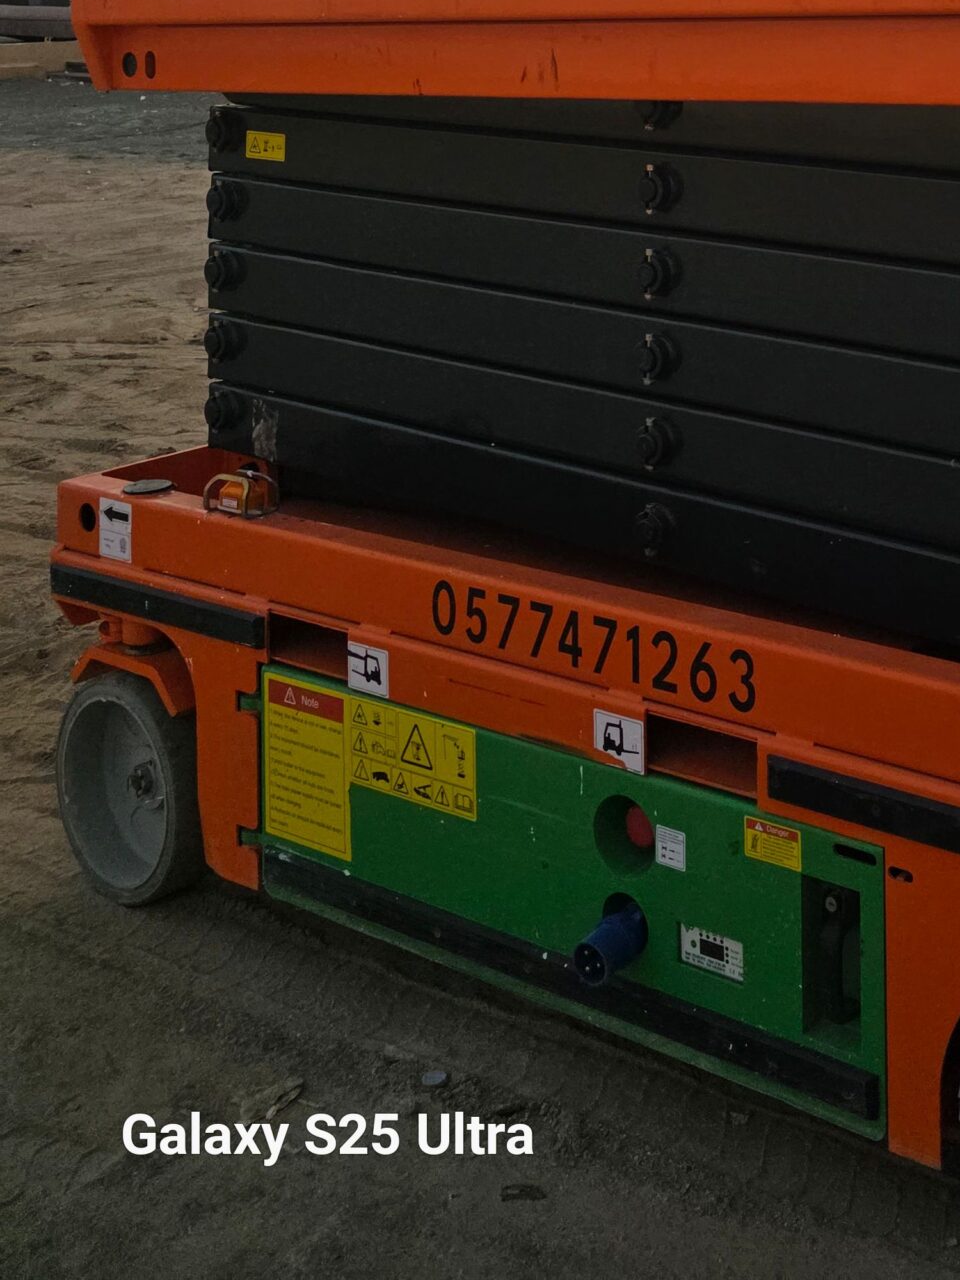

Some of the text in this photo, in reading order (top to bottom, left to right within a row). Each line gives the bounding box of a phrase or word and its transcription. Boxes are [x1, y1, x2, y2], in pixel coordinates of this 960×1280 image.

[432, 580, 756, 712] 0577471263
[301, 695, 319, 709] Note
[766, 825, 789, 838] Danger
